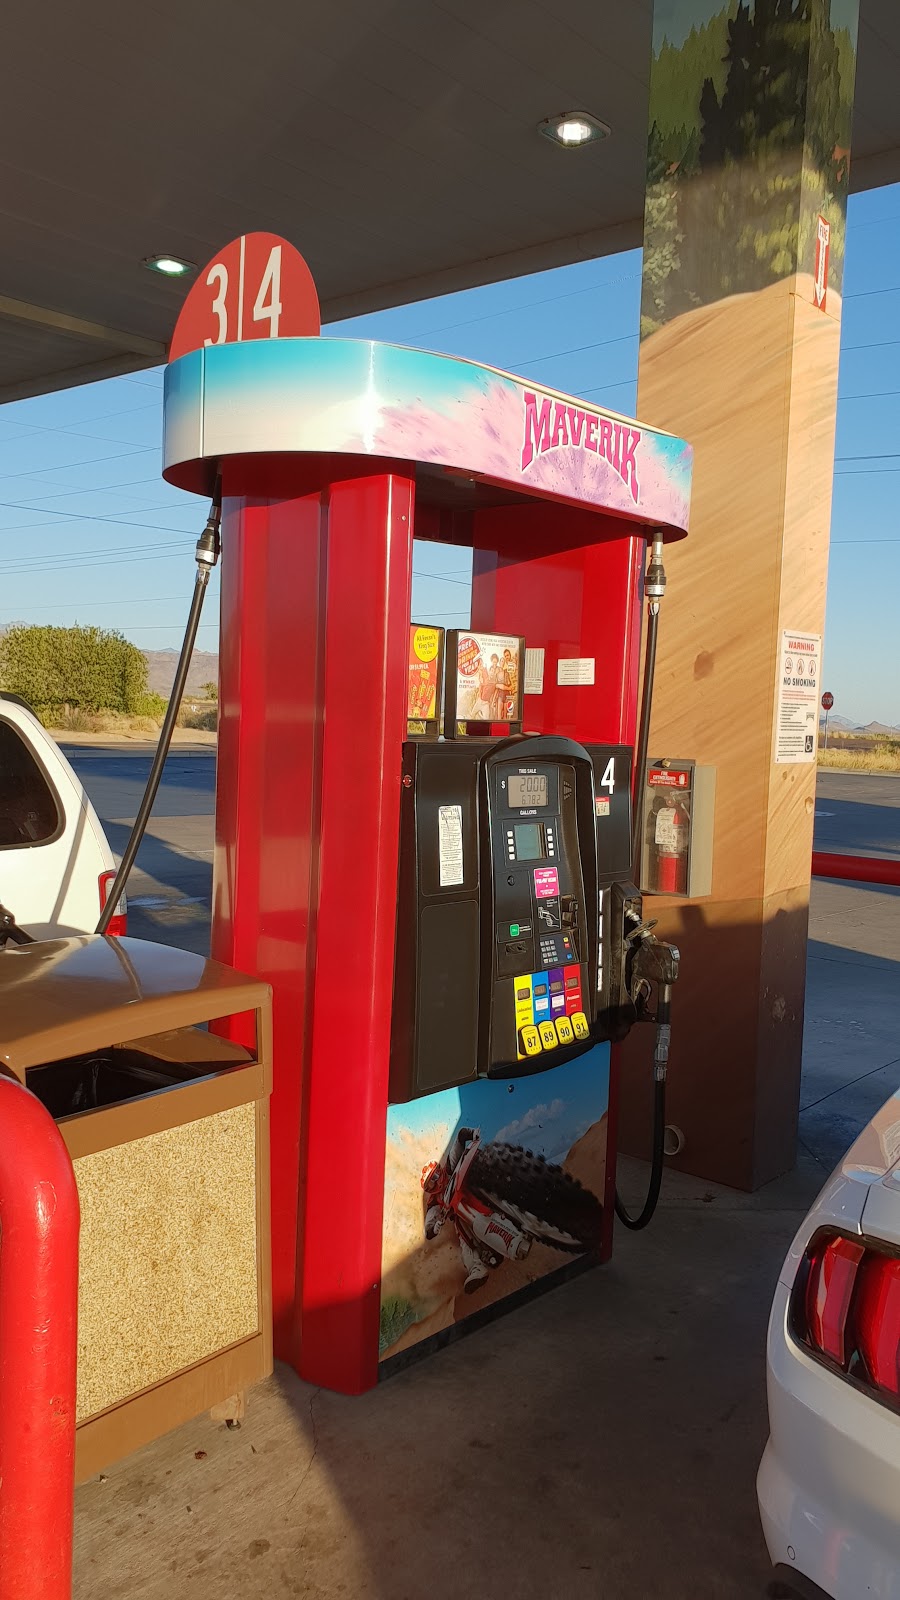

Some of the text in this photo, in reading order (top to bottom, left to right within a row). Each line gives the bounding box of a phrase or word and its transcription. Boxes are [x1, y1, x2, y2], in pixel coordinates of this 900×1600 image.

[204, 245, 282, 347] 3 4
[521, 390, 641, 505] MAVERIK
[788, 641, 815, 651] WARNING
[783, 677, 816, 687] NO SMOKING
[822, 696, 834, 705] STOP
[601, 757, 615, 795] 4
[520, 776, 546, 792] 20.00
[560, 1026, 570, 1038] 90
[575, 1022, 586, 1033] 91
[526, 1036, 537, 1048] 87
[543, 1031, 554, 1042] 89
